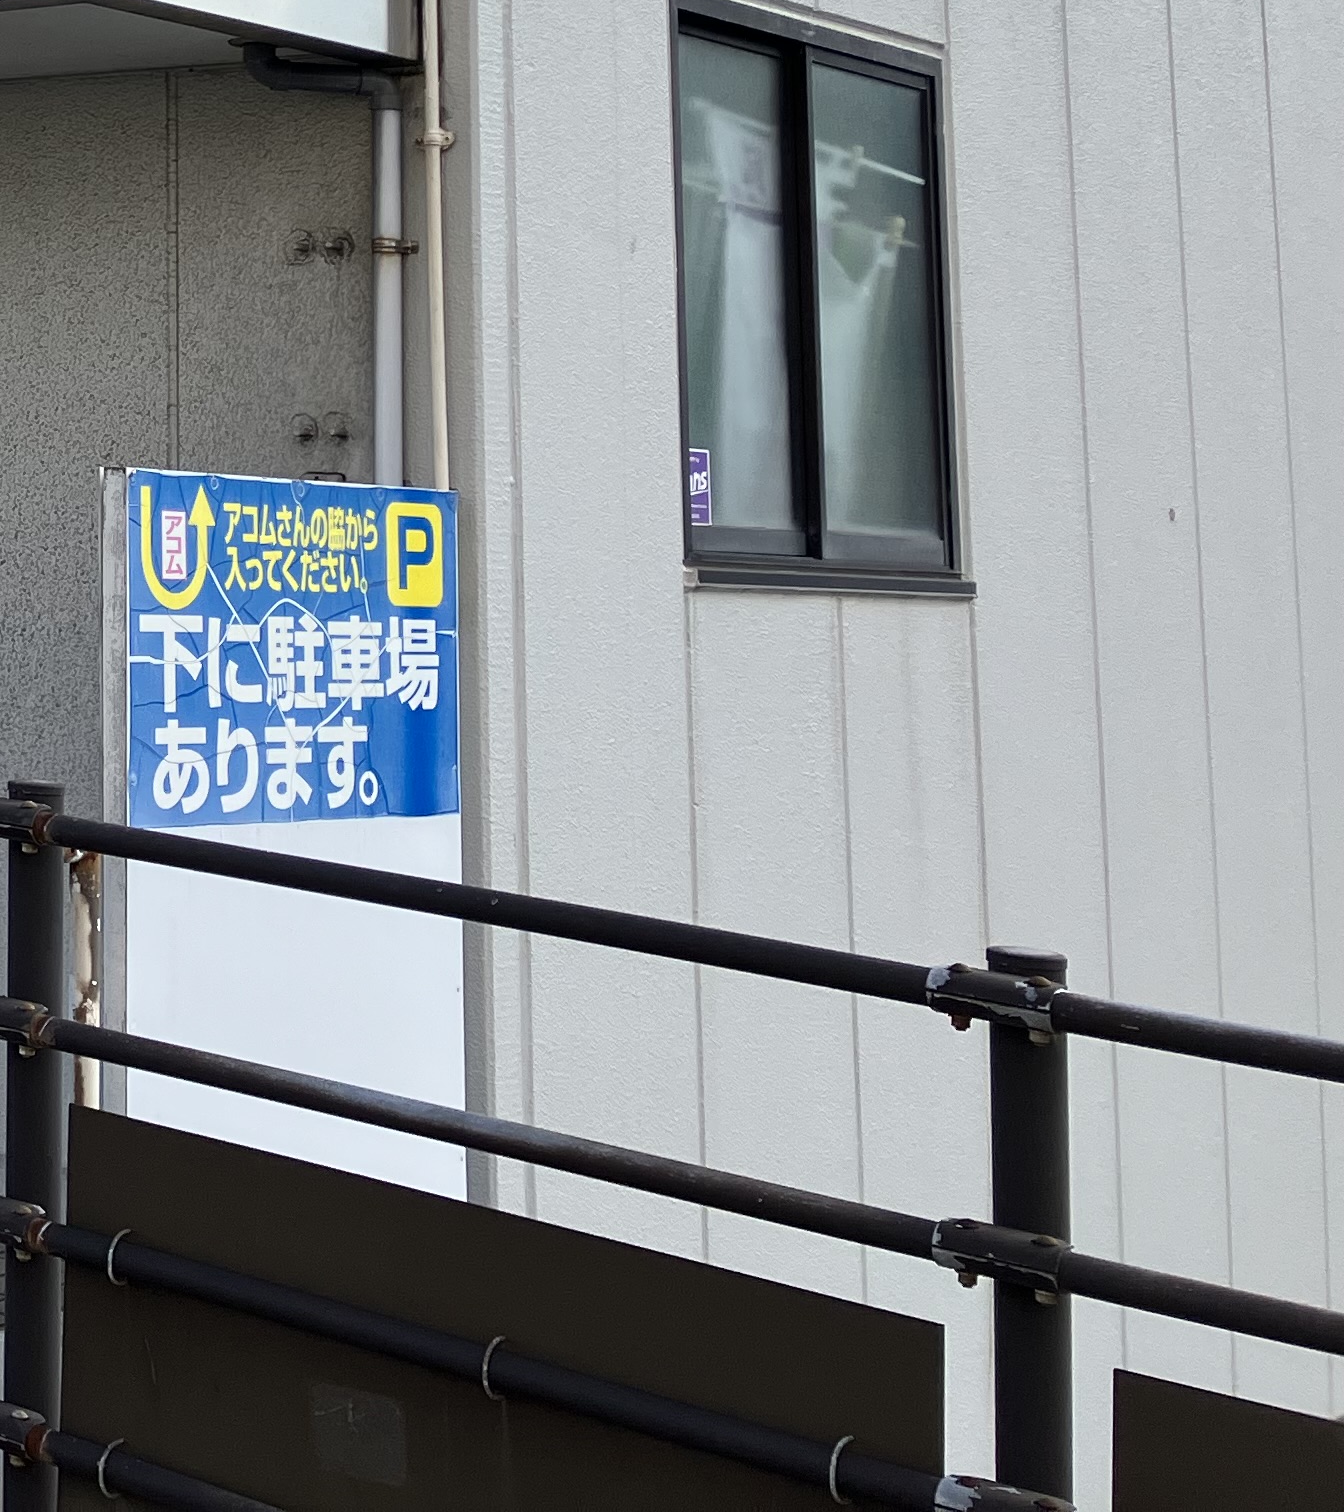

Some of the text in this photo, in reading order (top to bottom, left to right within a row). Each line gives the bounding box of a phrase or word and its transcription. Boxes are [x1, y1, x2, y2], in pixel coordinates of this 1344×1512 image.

[164, 514, 186, 577] アコム
[222, 503, 378, 550] アコムさんの脇から
[399, 516, 433, 591] P
[224, 547, 369, 594] 入ってください。
[138, 614, 440, 713] 下に駐車場
[152, 718, 380, 815] あります。
